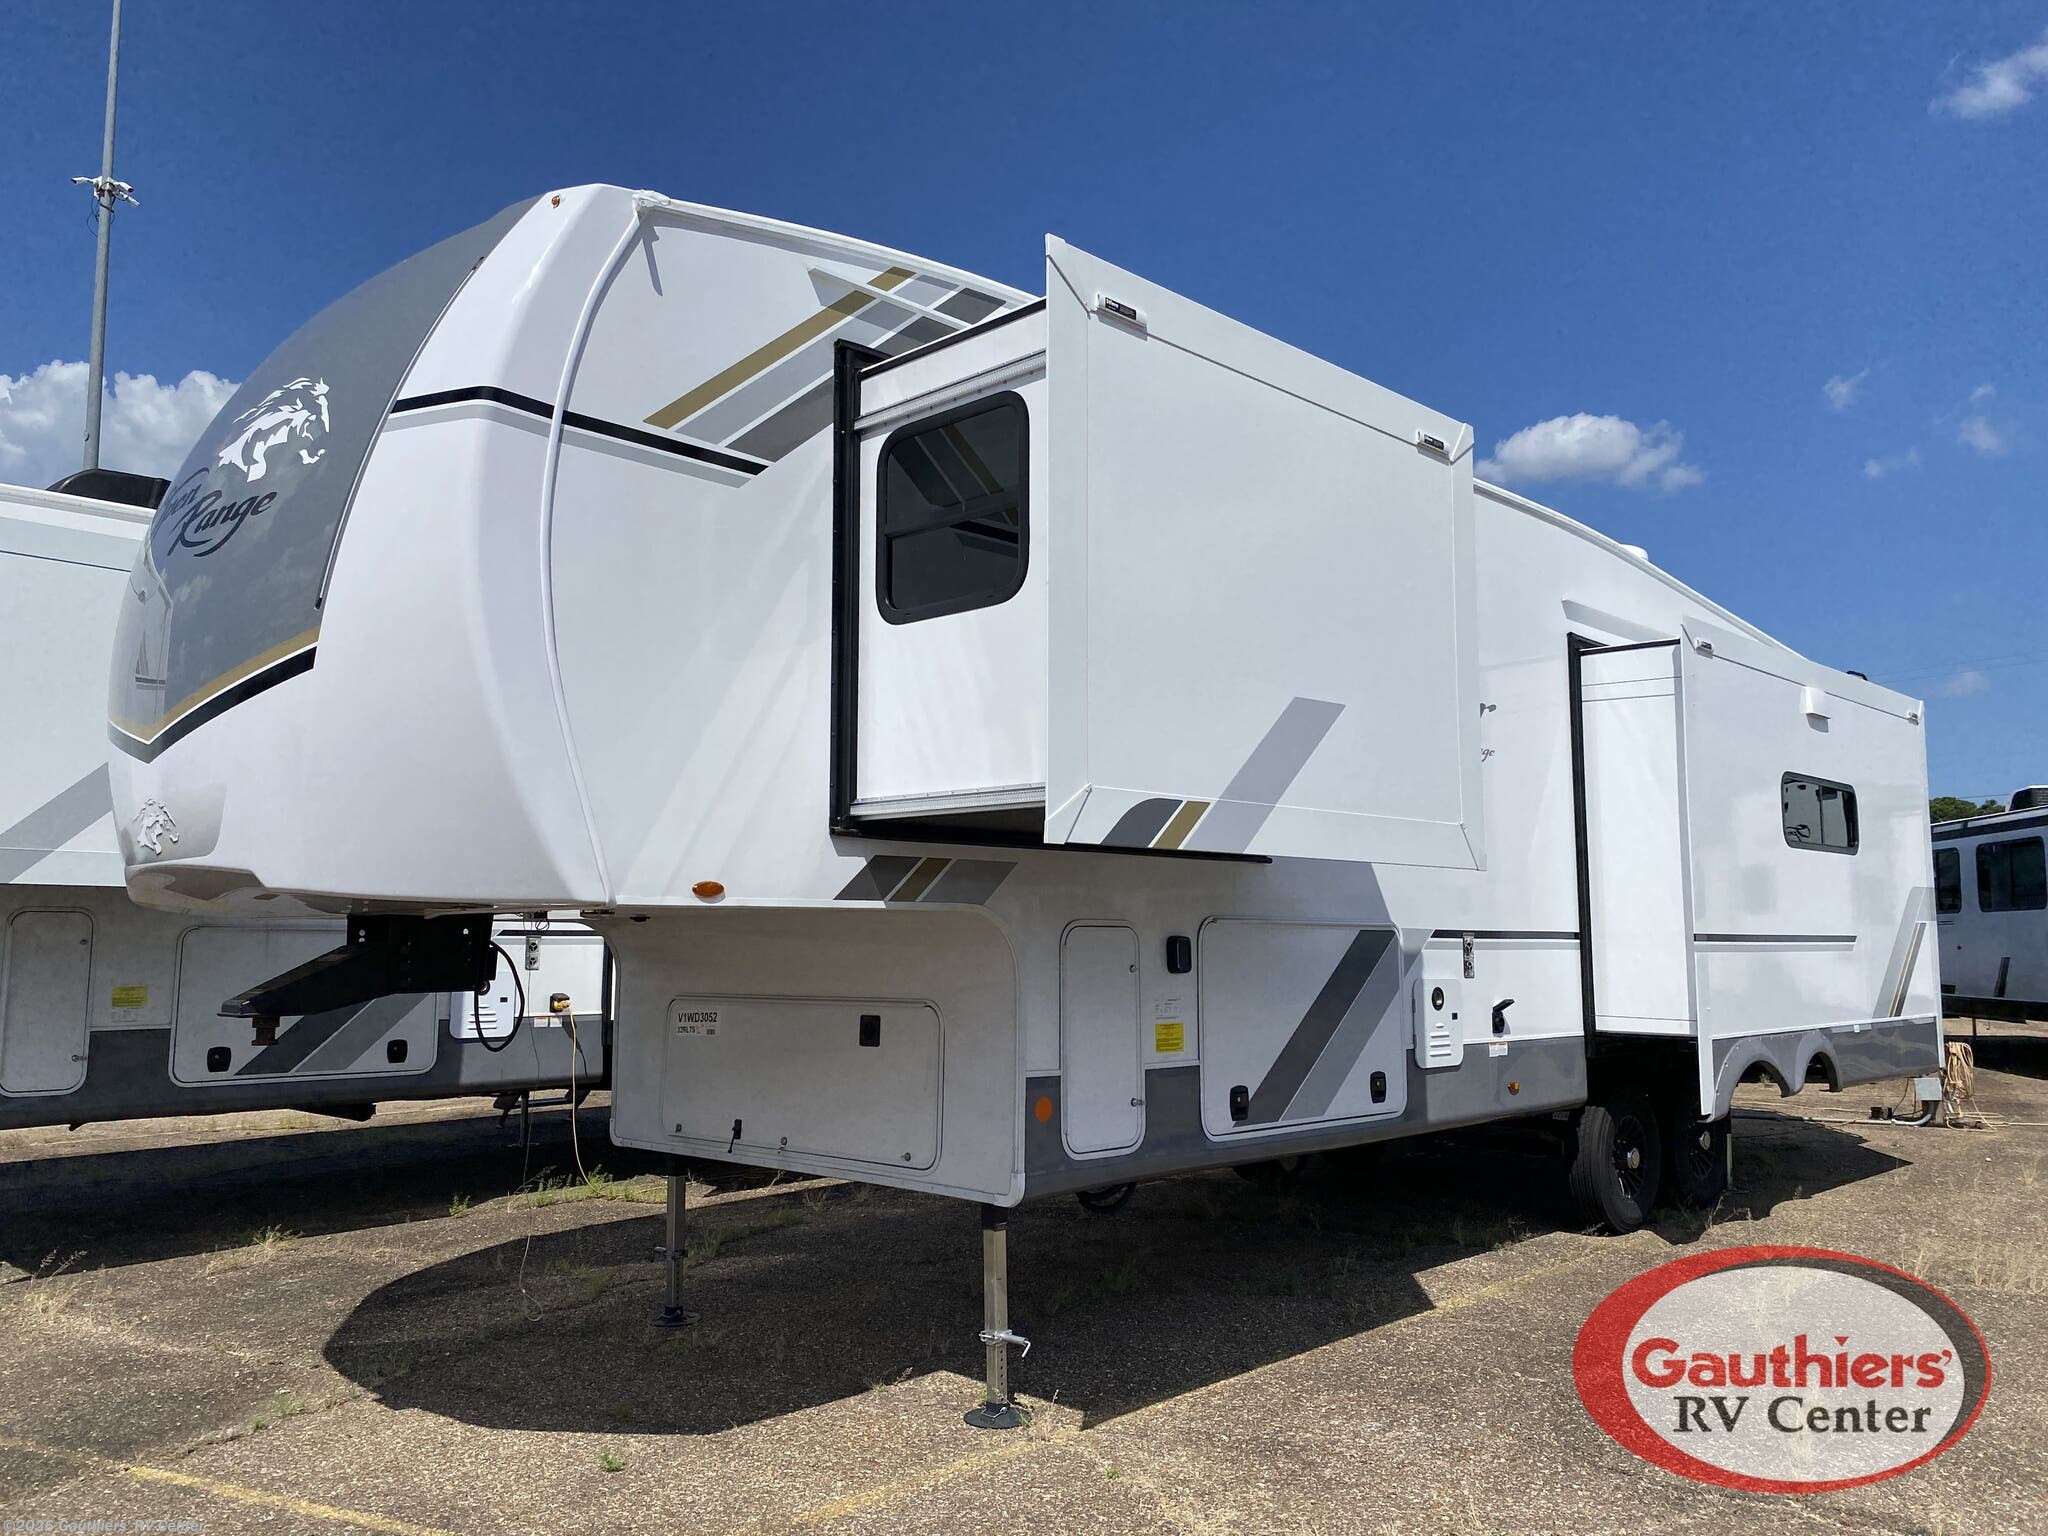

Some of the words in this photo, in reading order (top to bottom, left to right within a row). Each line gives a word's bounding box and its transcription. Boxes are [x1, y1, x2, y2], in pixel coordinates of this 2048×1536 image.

[151, 467, 210, 540] pen
[167, 489, 278, 558] Range
[678, 1012, 718, 1023] V1WD3052
